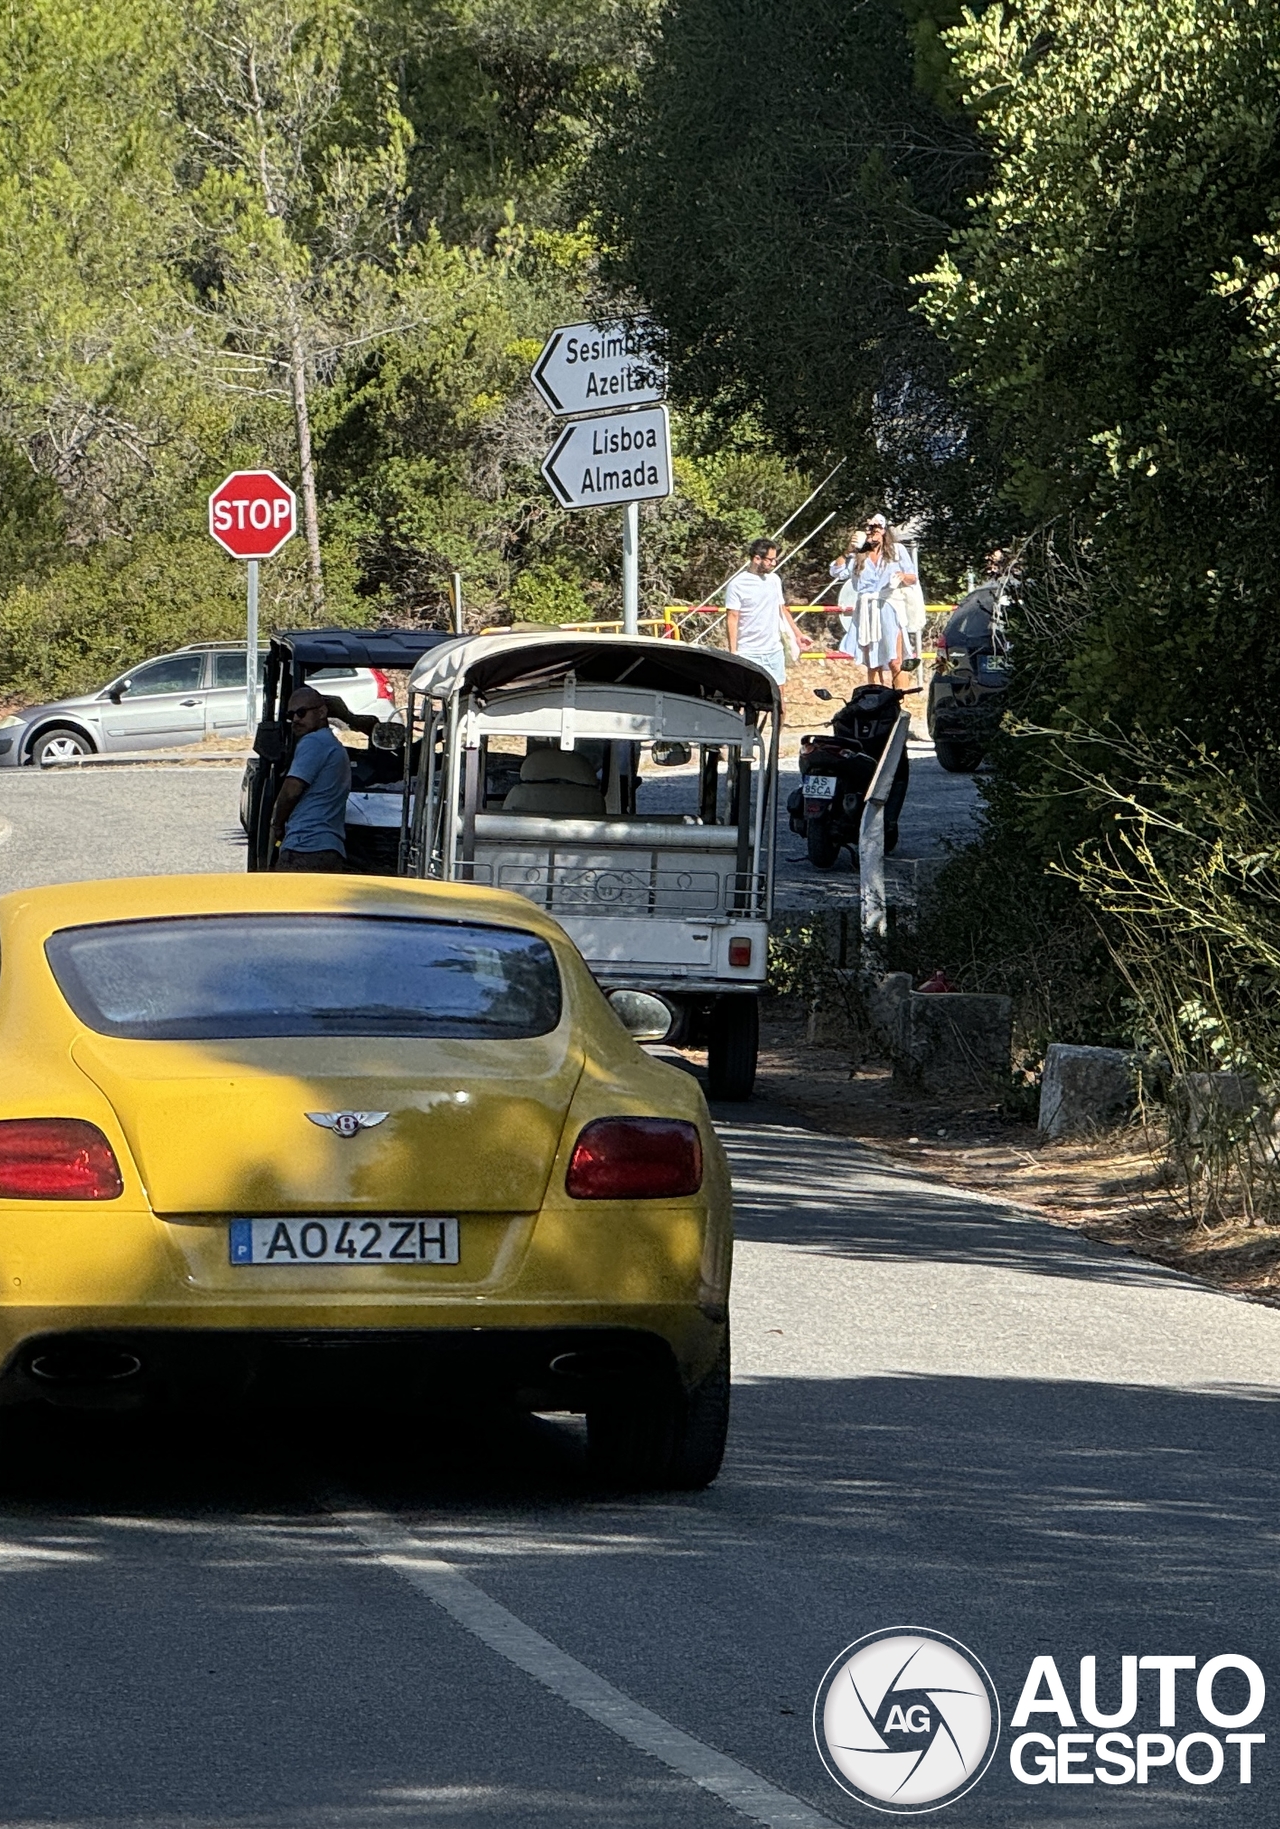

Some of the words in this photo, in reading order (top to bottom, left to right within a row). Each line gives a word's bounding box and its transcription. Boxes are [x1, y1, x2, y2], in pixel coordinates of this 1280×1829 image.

[593, 427, 656, 455] Lisboa
[581, 461, 658, 494] Almada
[214, 499, 290, 530] STOP
[813, 777, 828, 786] AS
[238, 1246, 247, 1255] P
